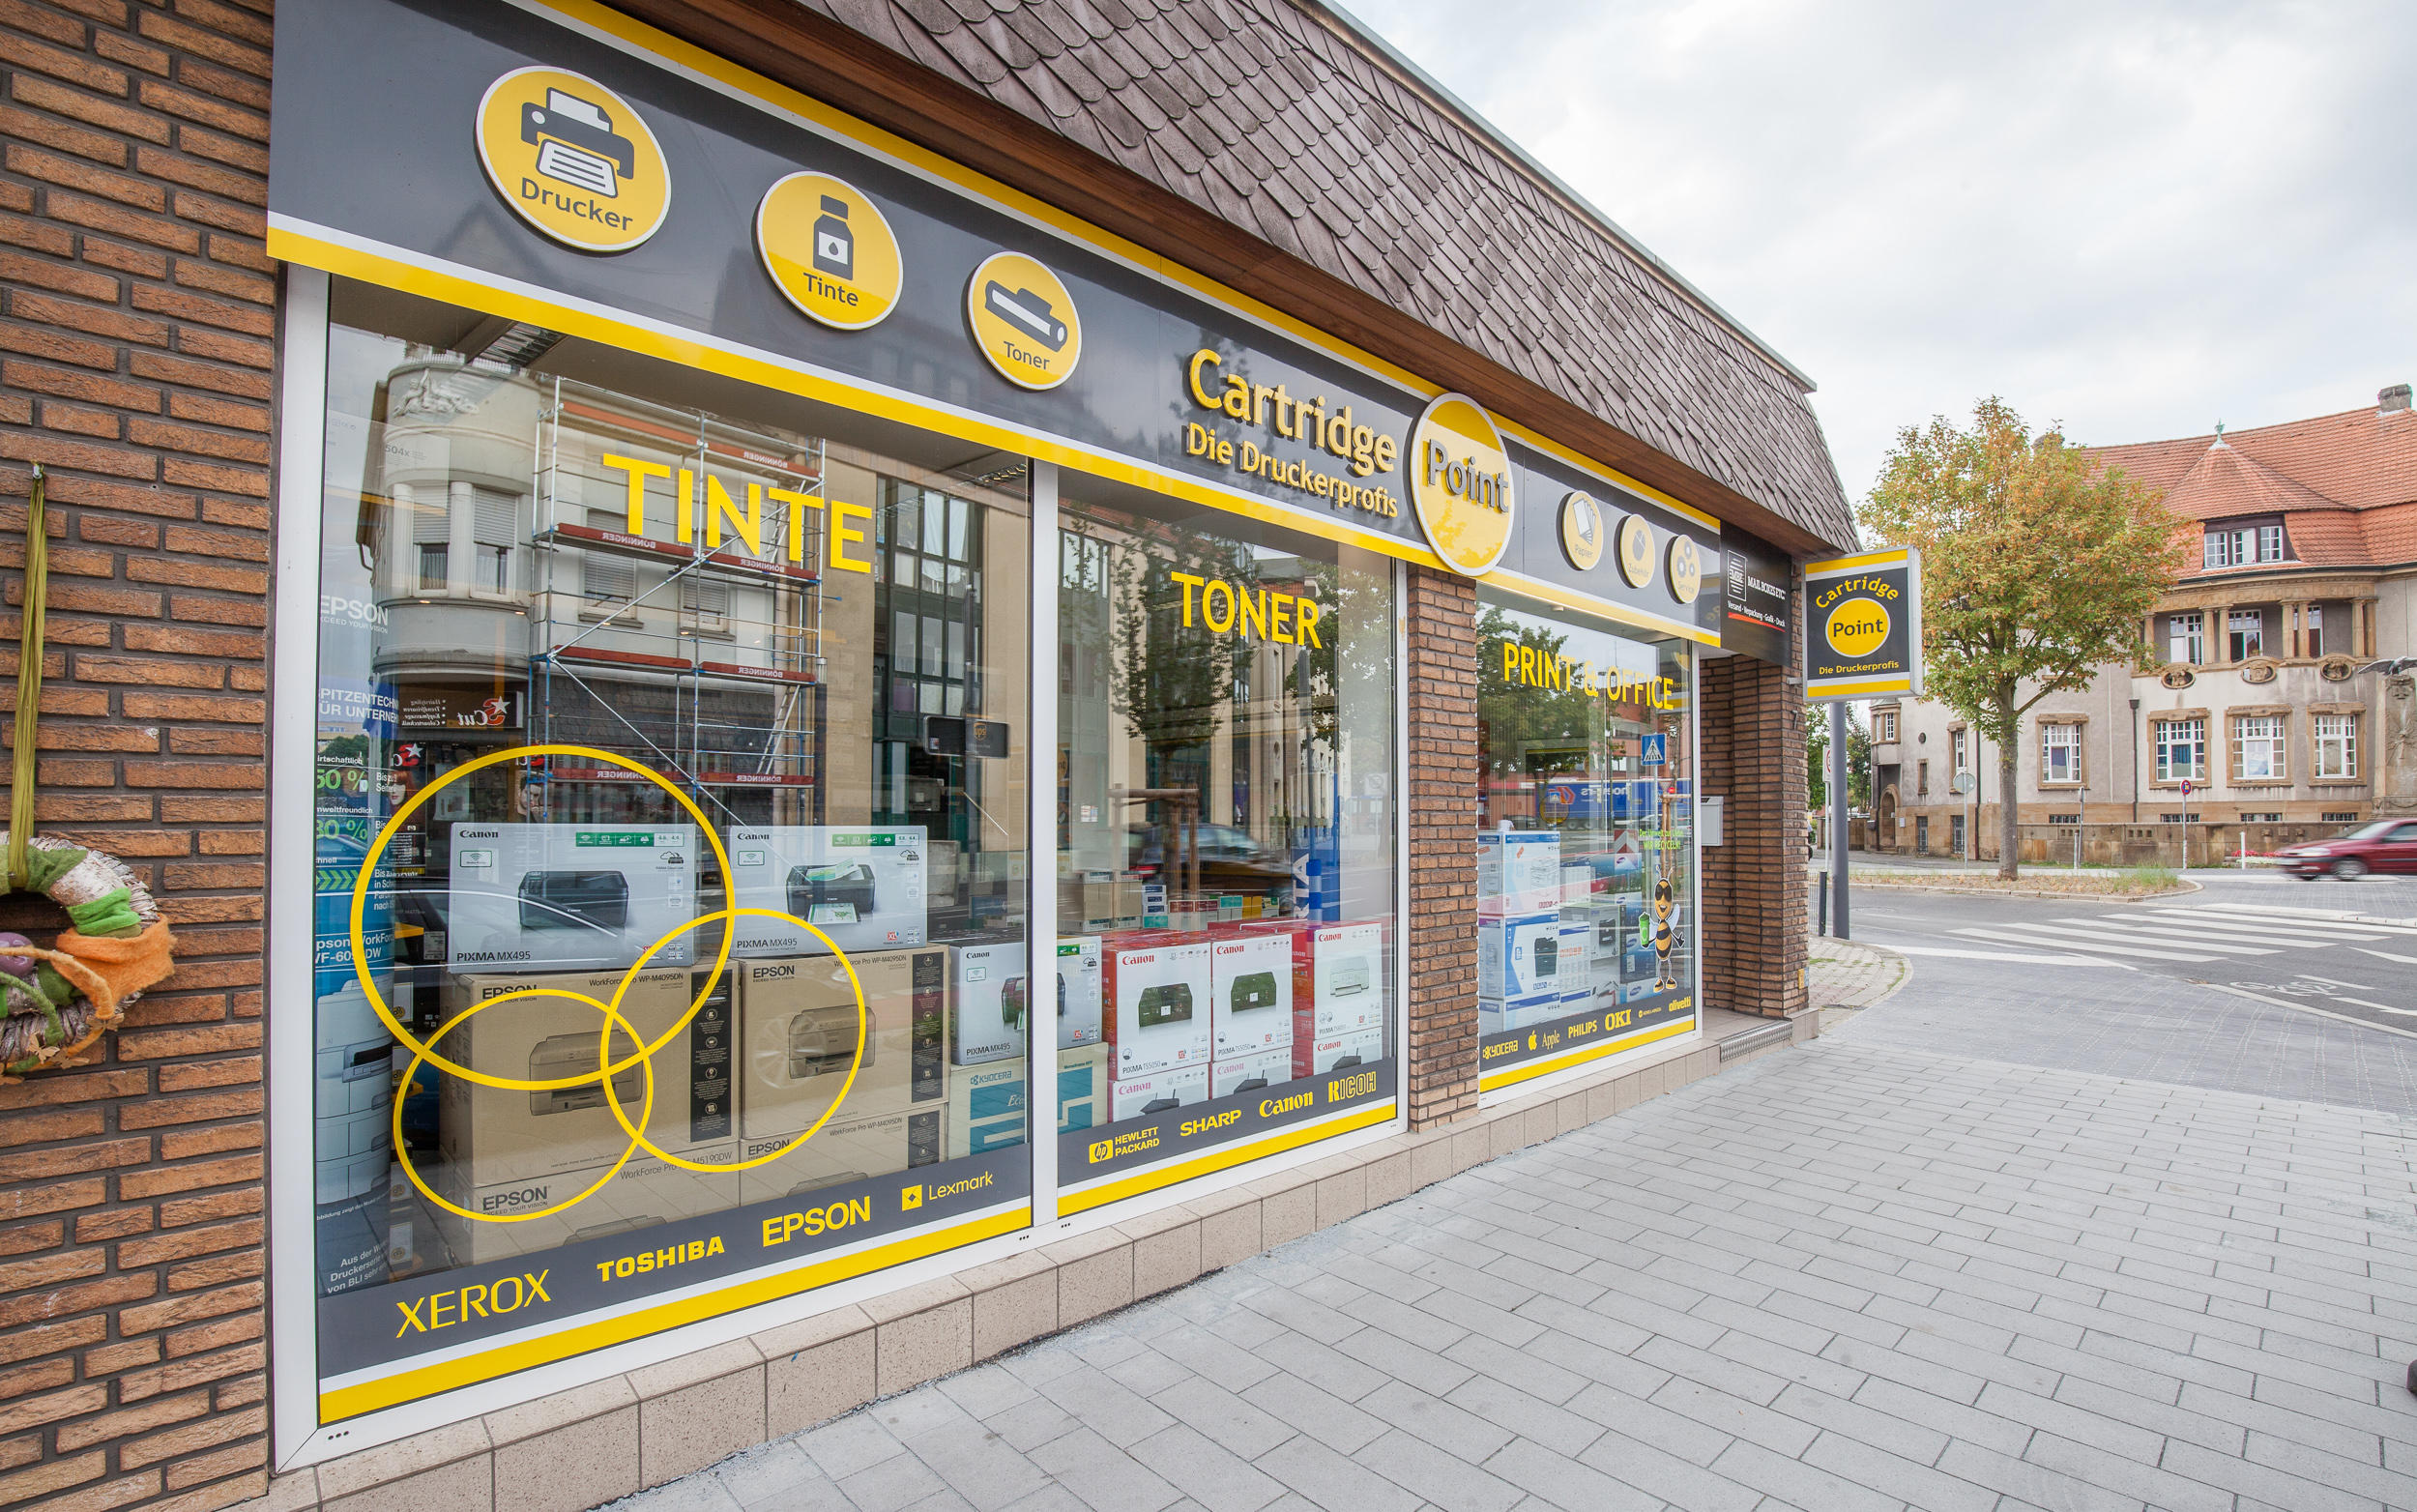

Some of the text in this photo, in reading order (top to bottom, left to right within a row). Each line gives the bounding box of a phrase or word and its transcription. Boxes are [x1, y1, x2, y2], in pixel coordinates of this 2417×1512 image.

[520, 177, 634, 233] Drucker
[802, 272, 859, 308] Tinte
[1004, 339, 1051, 371] Toner
[1189, 348, 1398, 477] Cartridge
[1186, 422, 1398, 518] Die Druckerprofis
[1428, 438, 1509, 513] Point
[603, 452, 873, 573] TINTE
[1574, 543, 1594, 558] Papier
[1816, 576, 1899, 608] Cartridge
[320, 595, 388, 625] EPSON
[1171, 570, 1323, 649] TONER
[1833, 619, 1883, 637] Point
[1503, 642, 1674, 711] PRINT & OFFICE
[1819, 660, 1899, 675] Die Druckerprofis
[319, 700, 341, 715] ÜR
[459, 829, 499, 839] Canon
[738, 832, 770, 841] Canon
[315, 939, 351, 951] pson
[737, 938, 798, 948] PIXMA MX495
[1319, 933, 1342, 943] Canon
[456, 951, 531, 962] PIXMA MX495
[1216, 945, 1244, 955] Canon
[1122, 955, 1154, 966] Canon
[753, 965, 795, 978] EPSON
[589, 977, 622, 986] WorkForc
[1669, 996, 1692, 1012] olivetti
[1568, 1020, 1598, 1039] PHILIPS
[1605, 1009, 1632, 1032] OKI
[1317, 1040, 1341, 1052] Canon
[1487, 1039, 1518, 1059] KYOCERA
[1542, 1030, 1560, 1049] Apple
[967, 1043, 1011, 1056] PIXMA MX495
[1122, 1063, 1143, 1074] PIXMA
[1217, 1062, 1244, 1075] Canon
[1119, 1082, 1151, 1095] Canon
[1327, 1071, 1377, 1103] RICOH
[1259, 1090, 1314, 1119] Canon
[1179, 1110, 1242, 1138] SHARP
[1115, 1127, 1159, 1146] HEWLETT
[748, 1139, 790, 1155] EPSON
[1094, 1141, 1108, 1162] hp
[1115, 1138, 1160, 1157] PACKARD
[928, 1171, 994, 1201] Lexmark
[482, 1185, 547, 1210] EPSON
[762, 1196, 871, 1247] EPSON
[597, 1236, 726, 1283] TOSHIBA
[395, 1268, 552, 1339] XEROX
